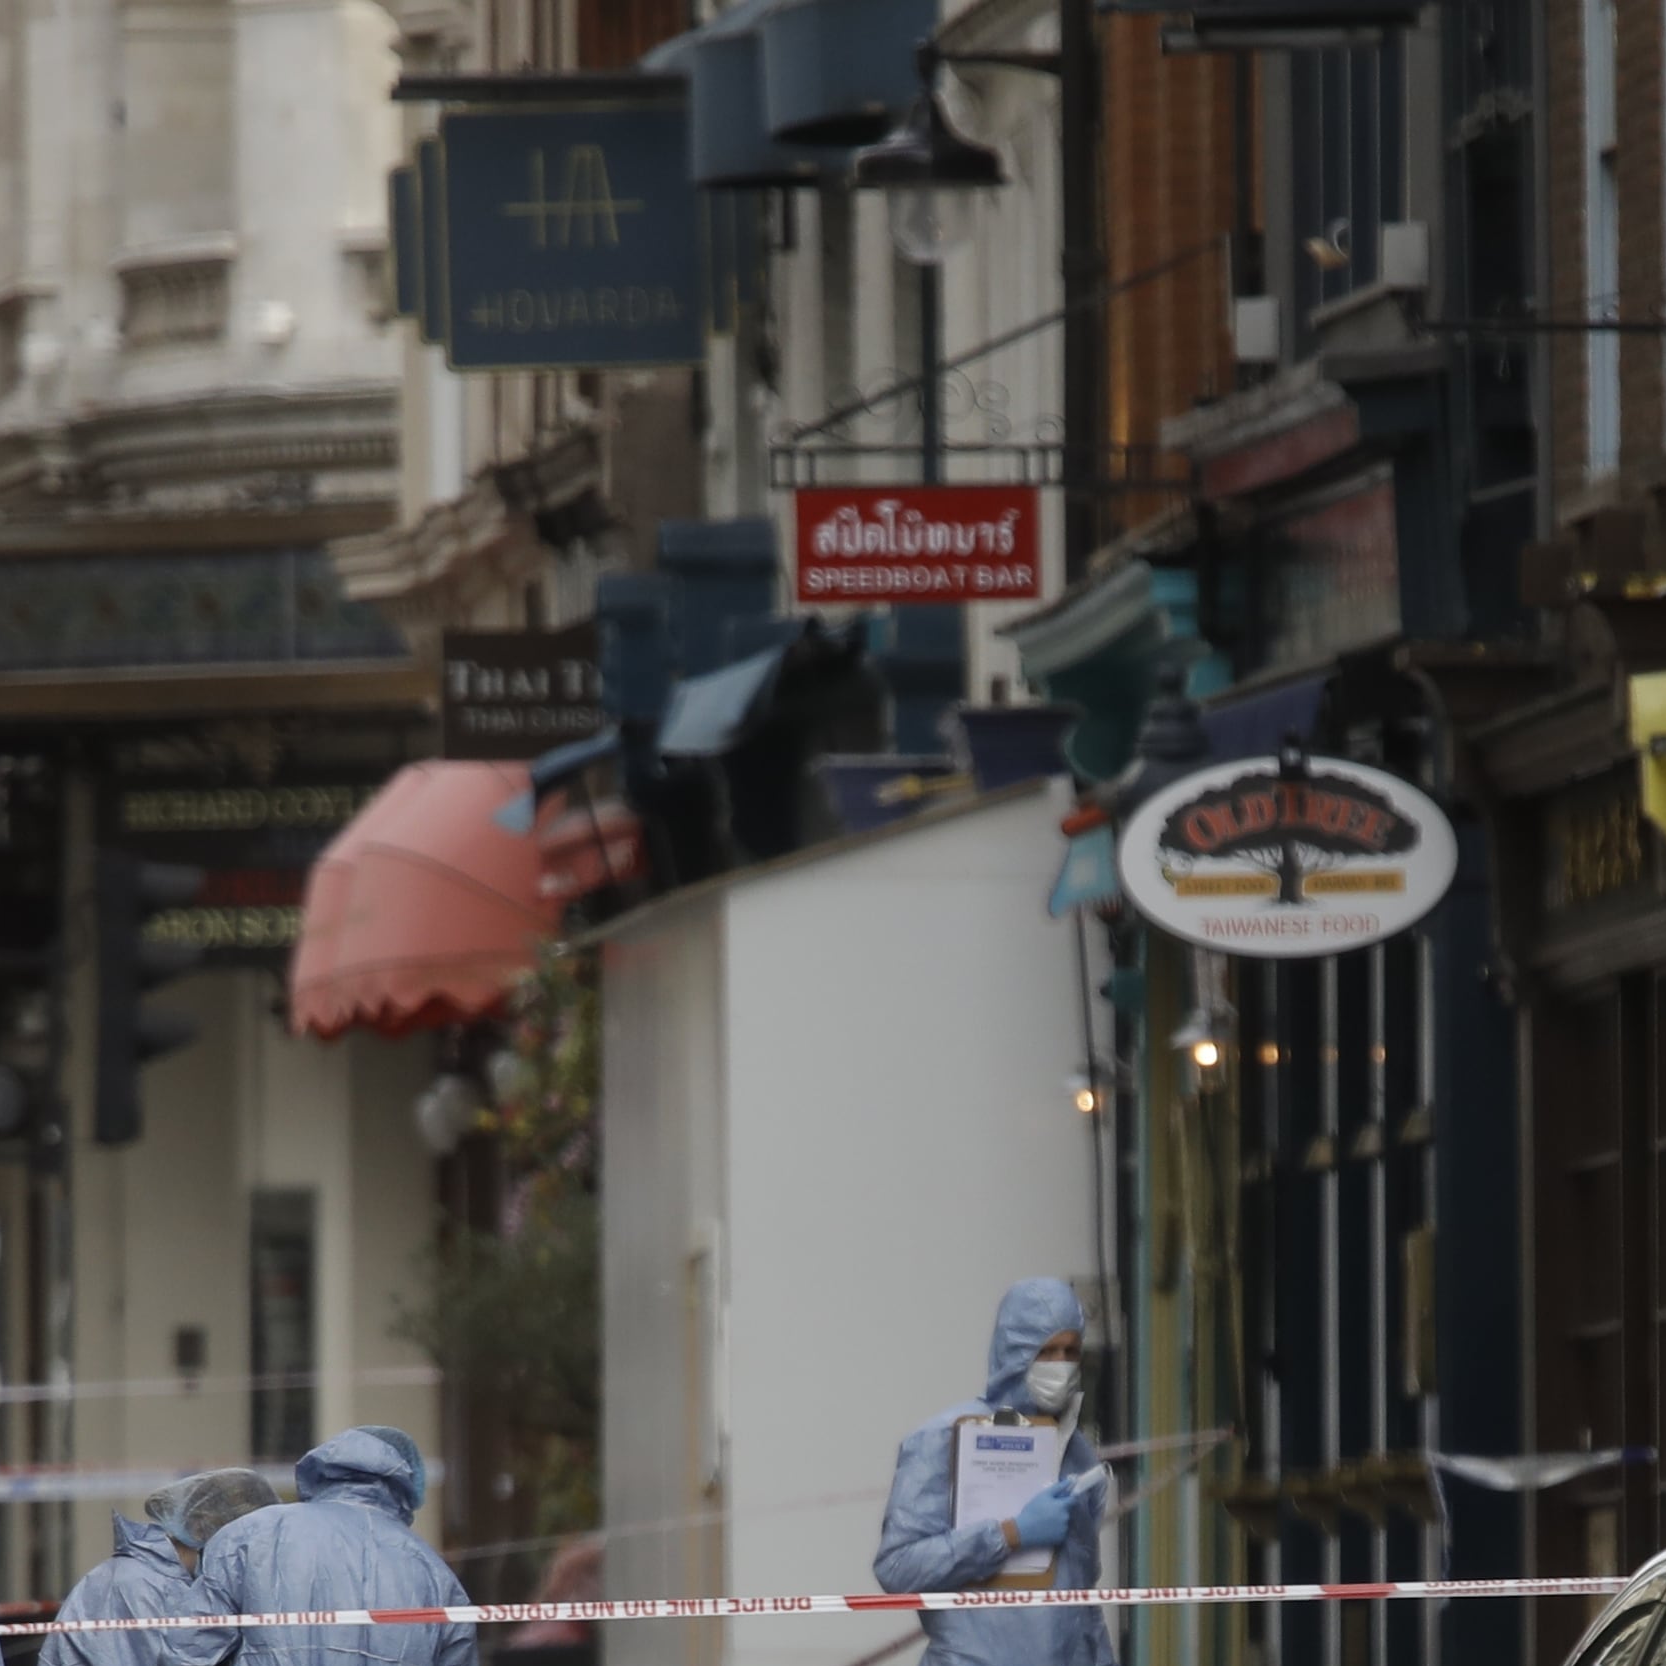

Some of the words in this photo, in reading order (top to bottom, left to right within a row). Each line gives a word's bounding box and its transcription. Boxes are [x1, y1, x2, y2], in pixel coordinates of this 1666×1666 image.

[806, 563, 969, 594] SPEEDBOAT
[973, 562, 1033, 593] BAR
[446, 659, 550, 700] THAI
[1185, 794, 1277, 848] OLD
[1274, 782, 1397, 849] TREE
[1201, 914, 1313, 938] TAIWANESE
[1321, 914, 1382, 935] FOOD
